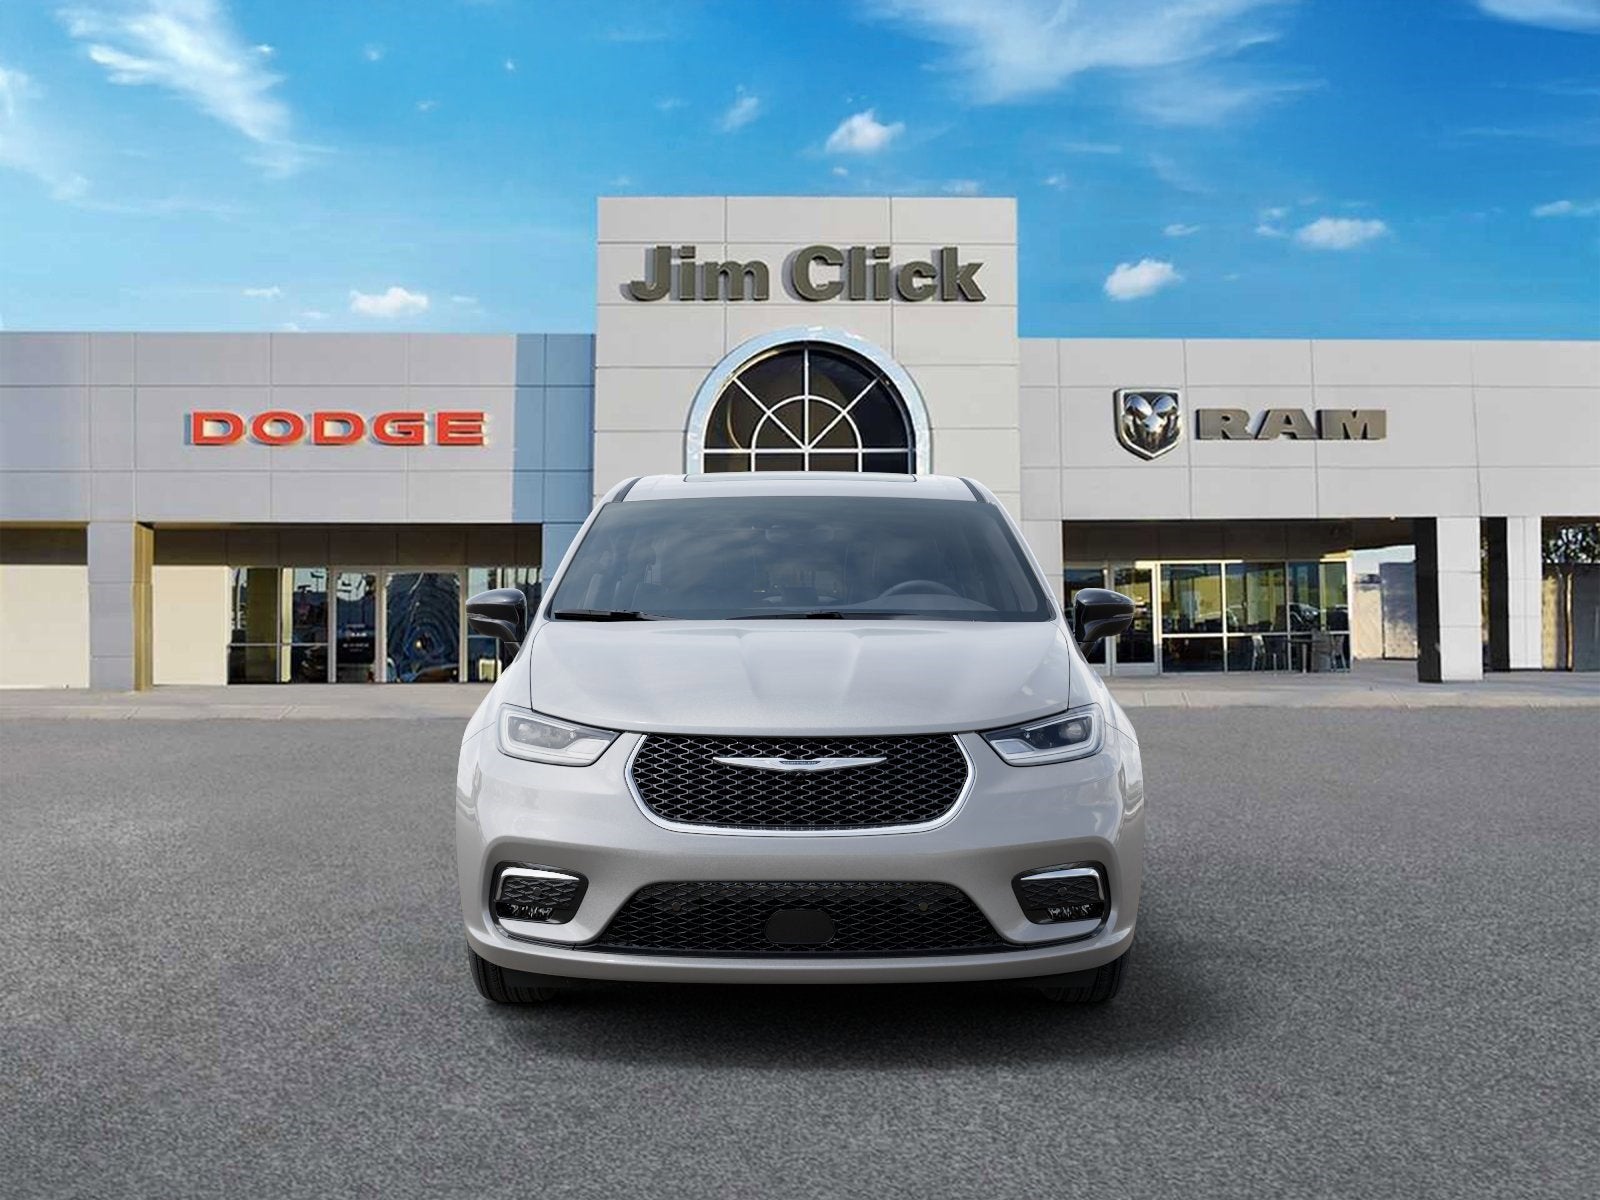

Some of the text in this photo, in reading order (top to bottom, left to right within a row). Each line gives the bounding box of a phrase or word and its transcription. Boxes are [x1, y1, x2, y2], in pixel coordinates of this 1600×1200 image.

[628, 244, 986, 302] Jim Click
[190, 411, 485, 446] DODGE
[1196, 408, 1387, 440] RAM
